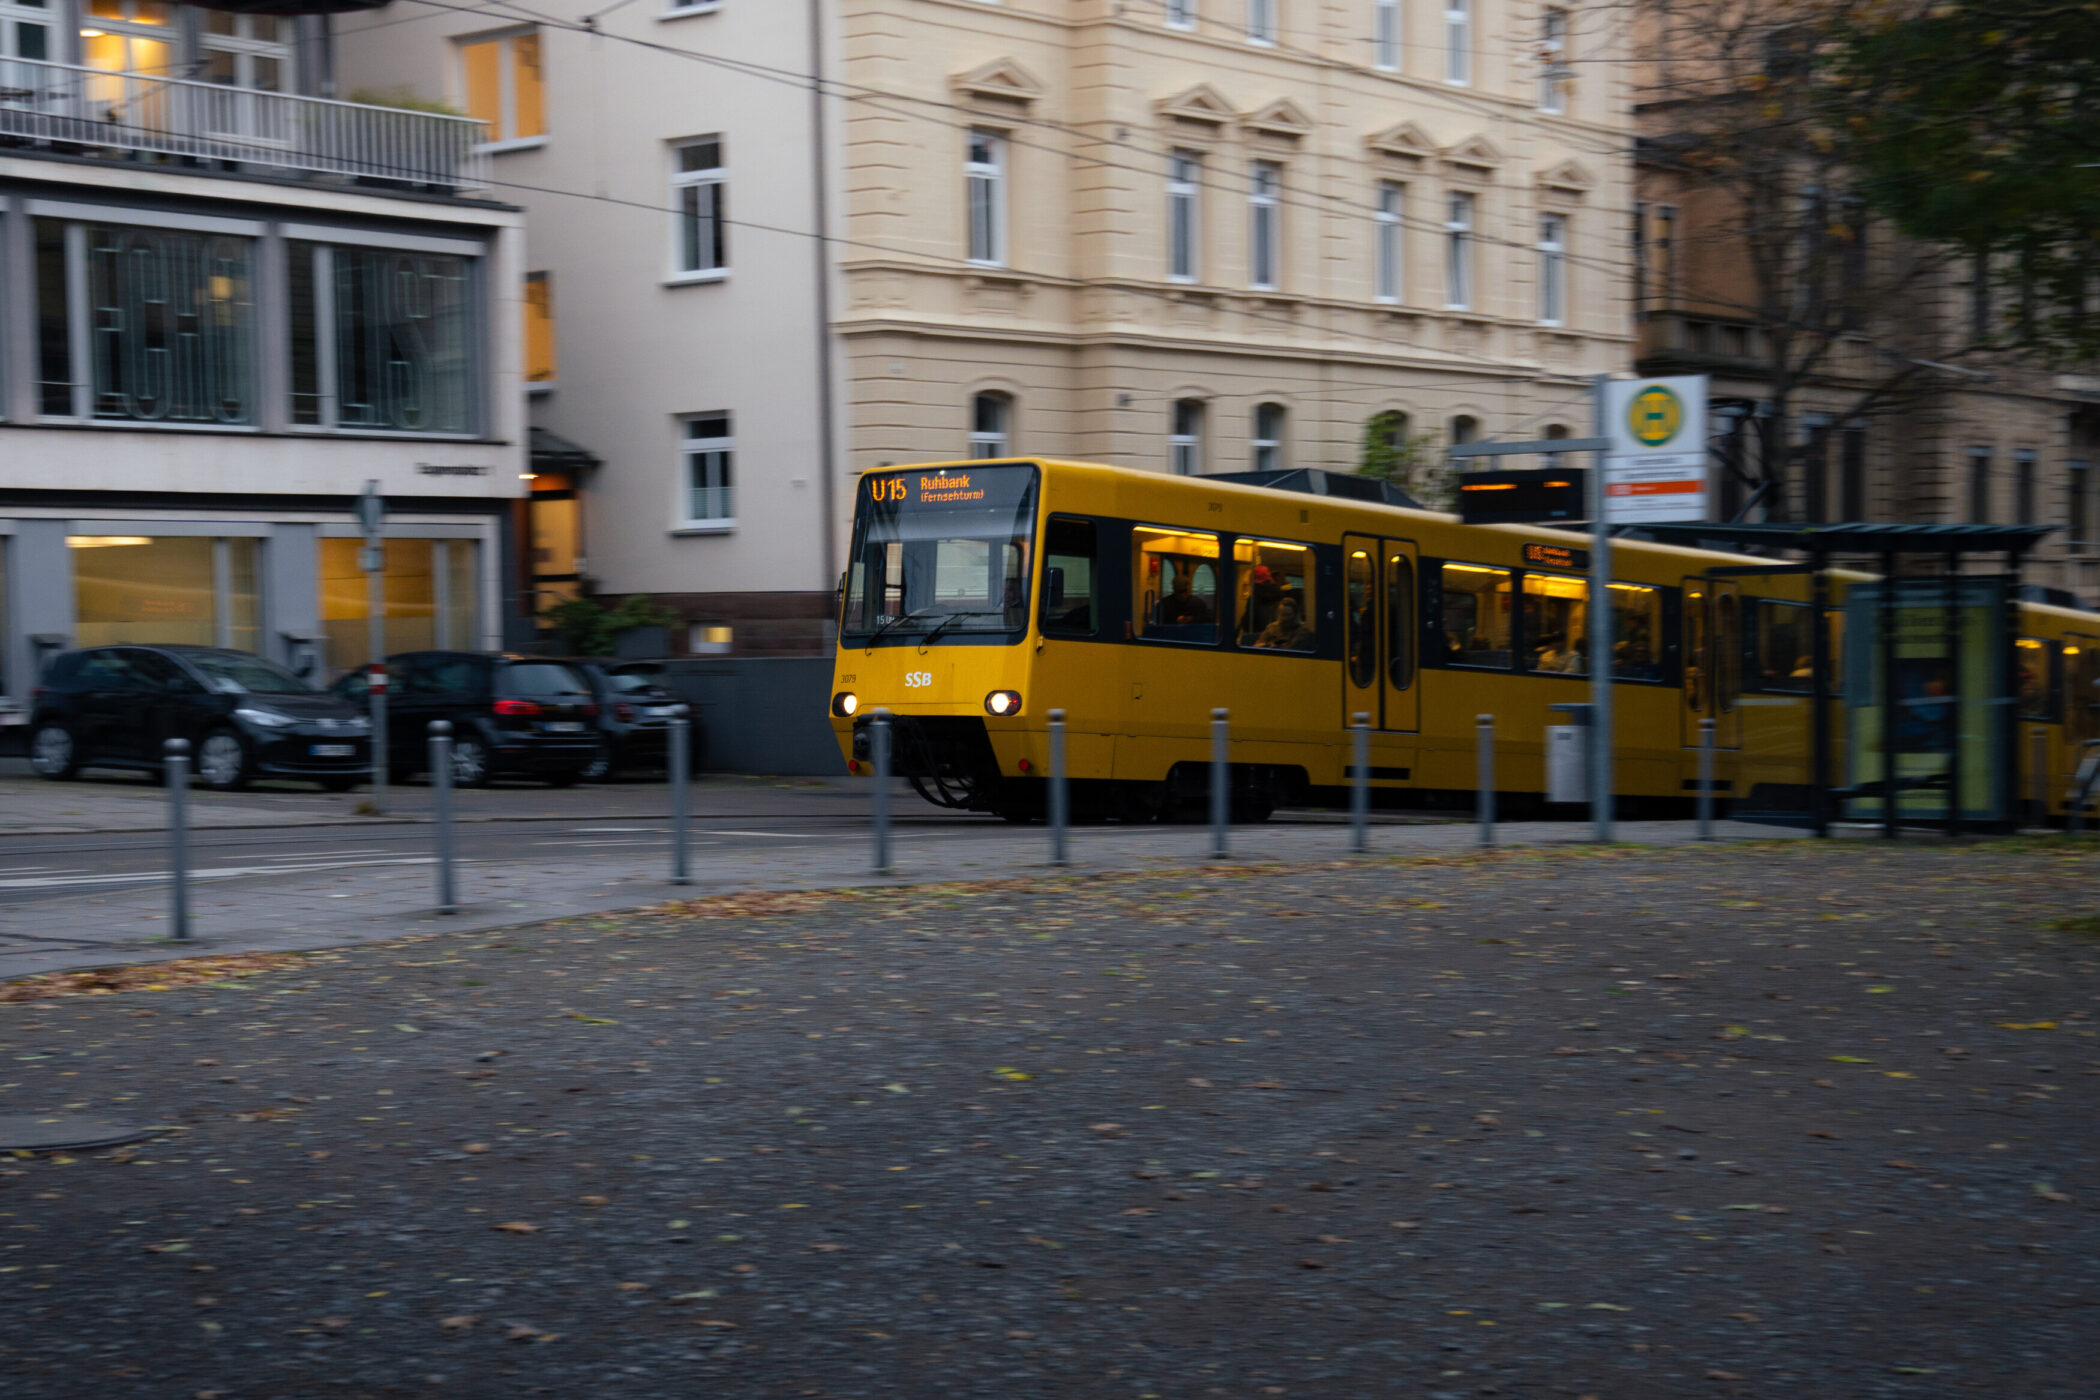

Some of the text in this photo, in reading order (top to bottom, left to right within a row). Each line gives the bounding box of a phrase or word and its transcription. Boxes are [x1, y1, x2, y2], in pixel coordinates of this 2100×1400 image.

[872, 478, 907, 501] U15
[920, 474, 970, 490] Ruhbank
[920, 488, 984, 502] (Fernsehturm)
[840, 674, 857, 684] 3079
[904, 671, 932, 688] SSB
